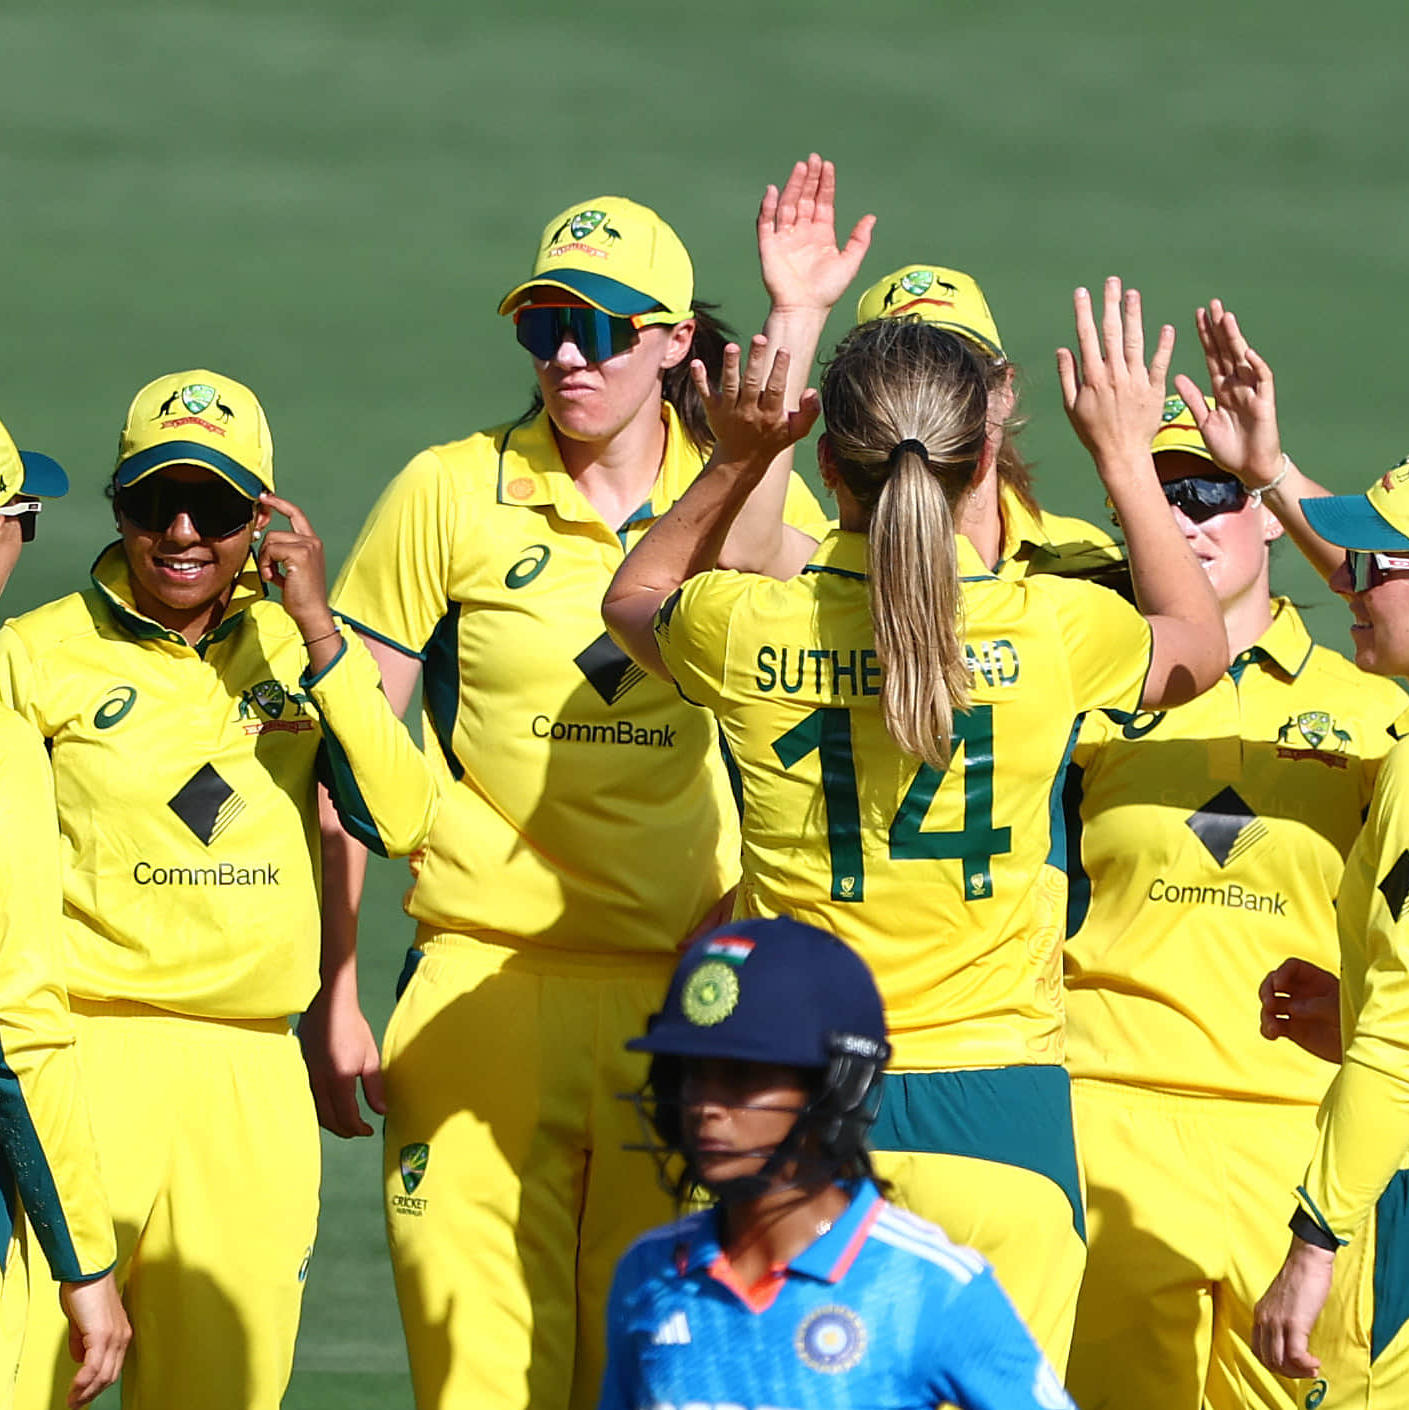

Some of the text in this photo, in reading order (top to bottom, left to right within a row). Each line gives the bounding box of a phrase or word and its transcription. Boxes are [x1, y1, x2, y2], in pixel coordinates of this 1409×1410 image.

[756, 639, 1020, 696] SUTHEND
[532, 715, 676, 747] CommBank
[771, 704, 1012, 902] 14
[133, 862, 280, 886] CommBank
[1148, 878, 1289, 917] CommBank
[392, 1196, 428, 1210] CRICKET
